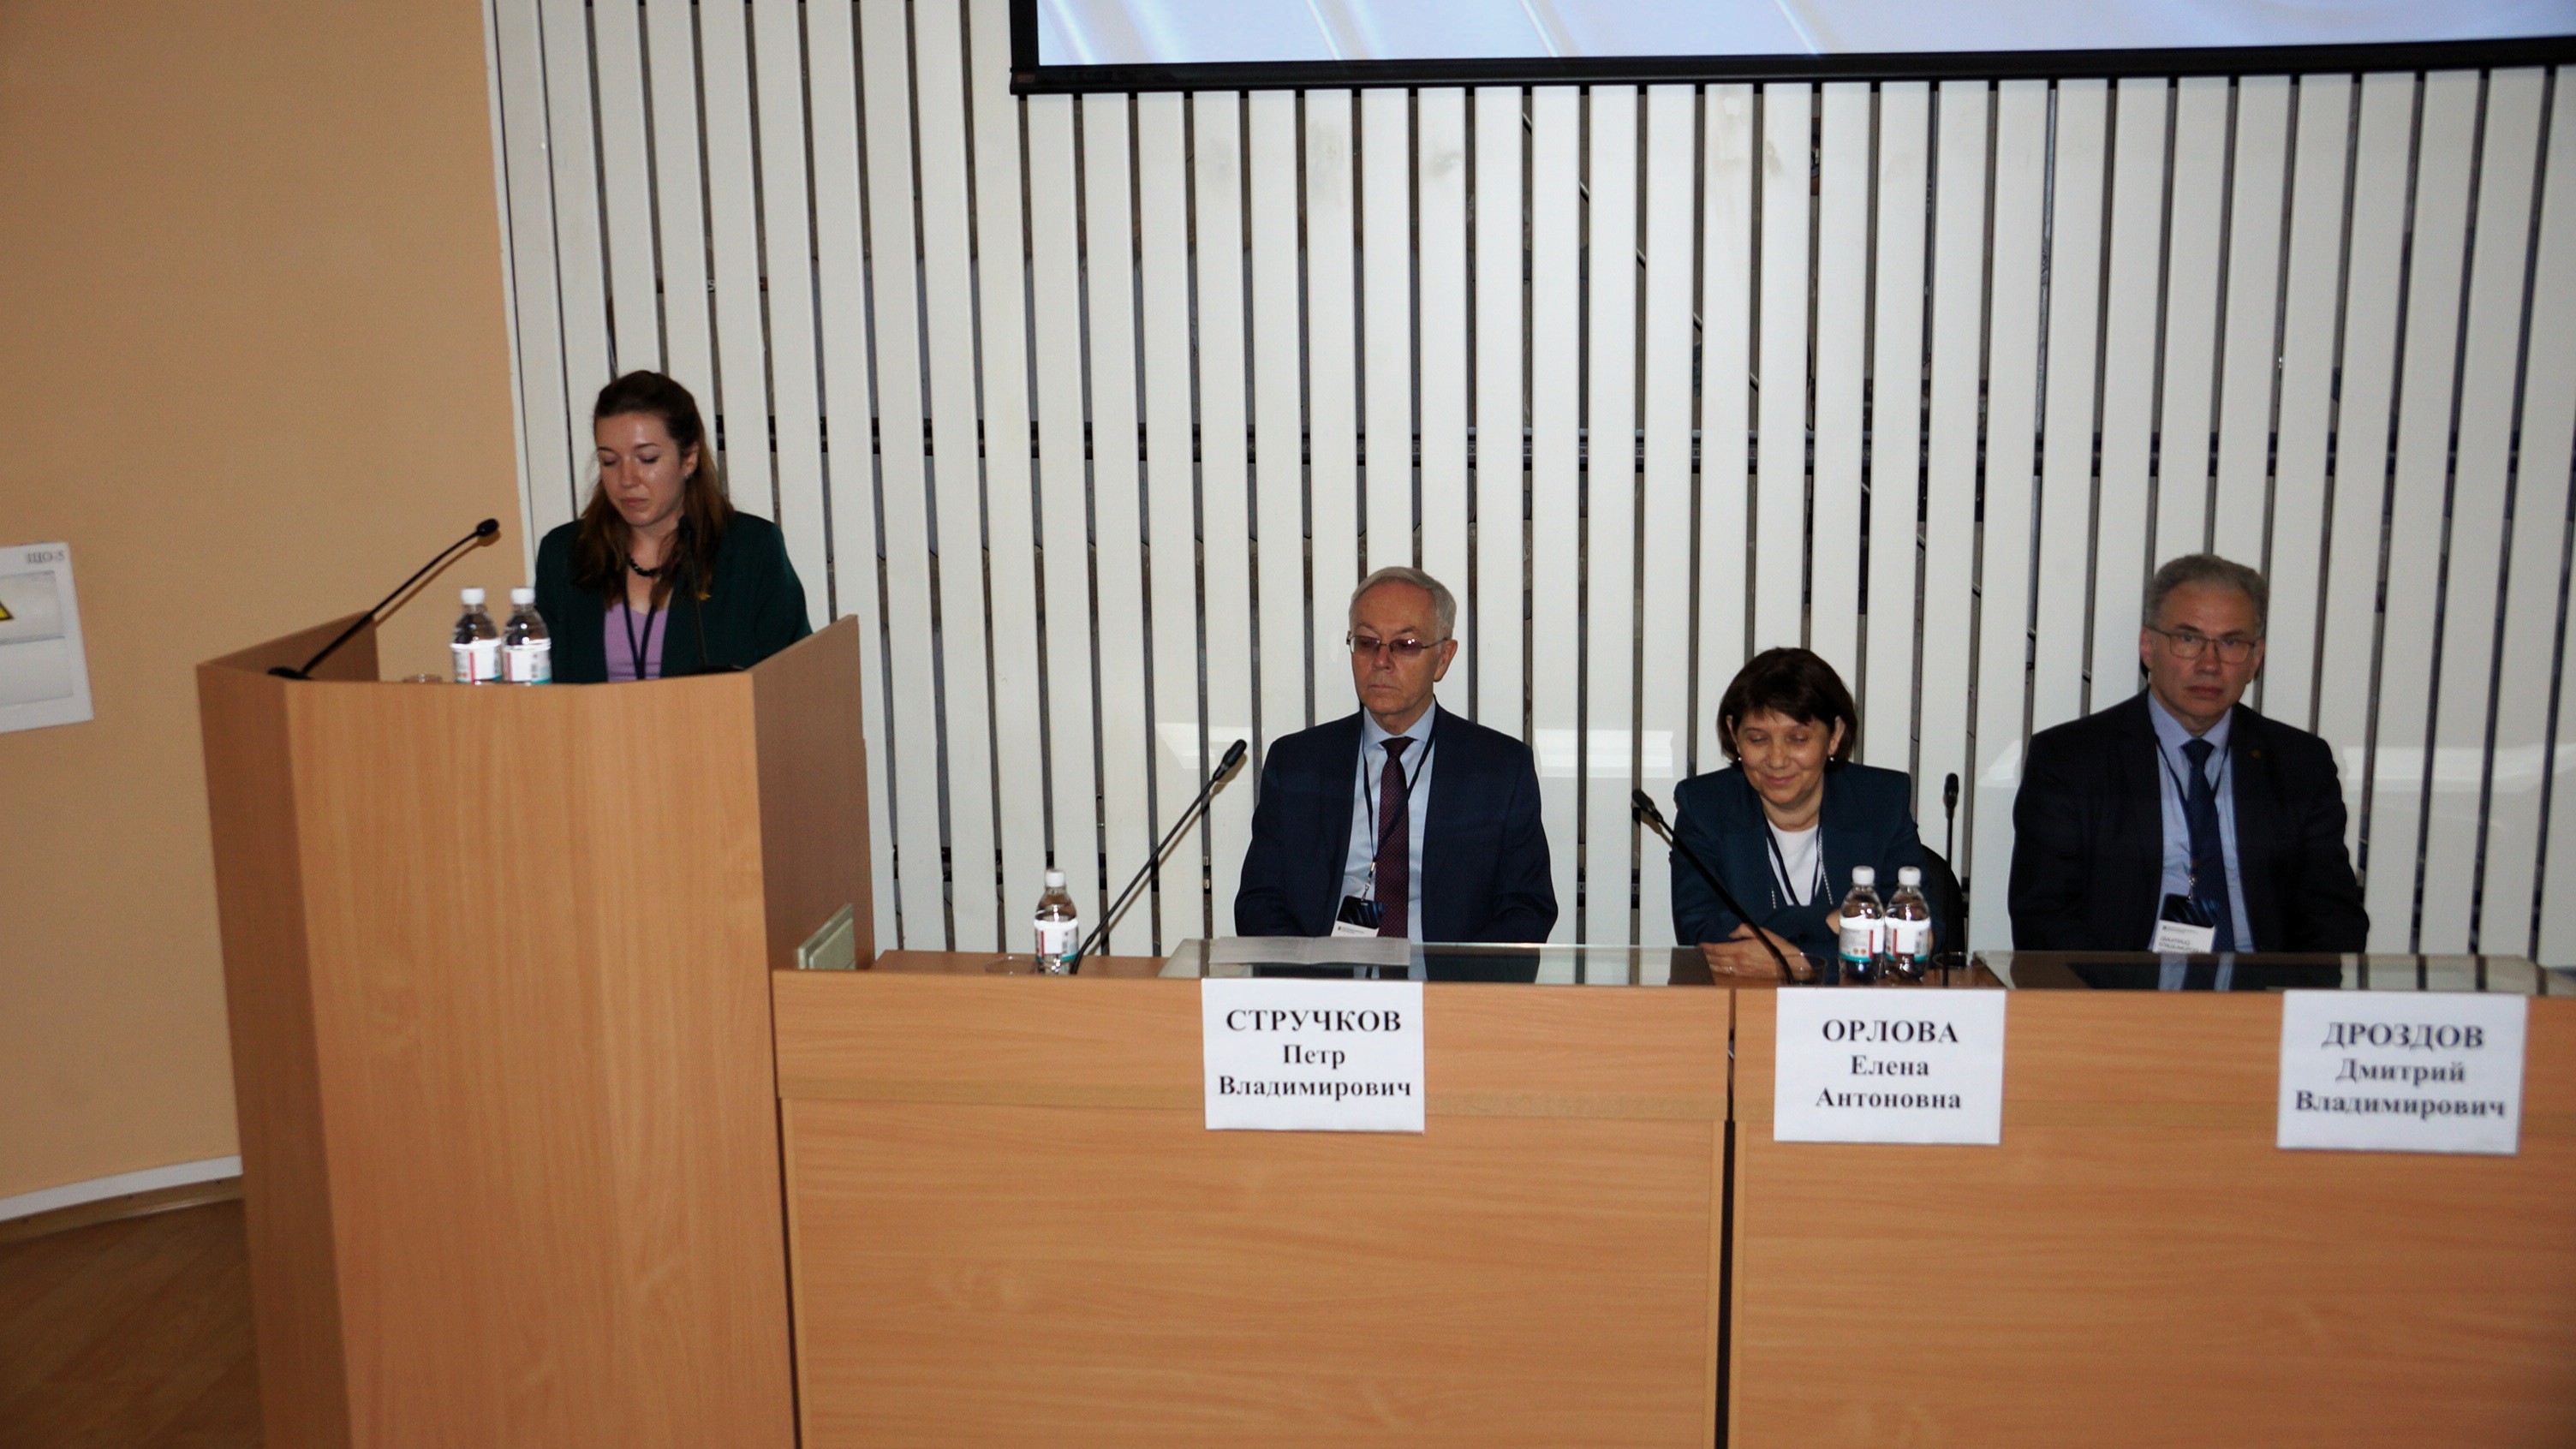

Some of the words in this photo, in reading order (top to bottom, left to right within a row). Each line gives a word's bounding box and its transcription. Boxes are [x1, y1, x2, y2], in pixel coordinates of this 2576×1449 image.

[1225, 1009, 1402, 1032] СТРУЧКОВ
[1822, 1018, 1959, 1043] ОРЛОВА
[2321, 1022, 2484, 1052] ДРОЗДОВ
[1283, 1044, 1346, 1070] Петр
[1850, 1054, 1929, 1076] Елена
[2334, 1058, 2466, 1088] Дмитрий
[1219, 1076, 1411, 1102] Владимирович
[1816, 1087, 1962, 1109] Антоновна
[2294, 1090, 2507, 1121] Владимирович
